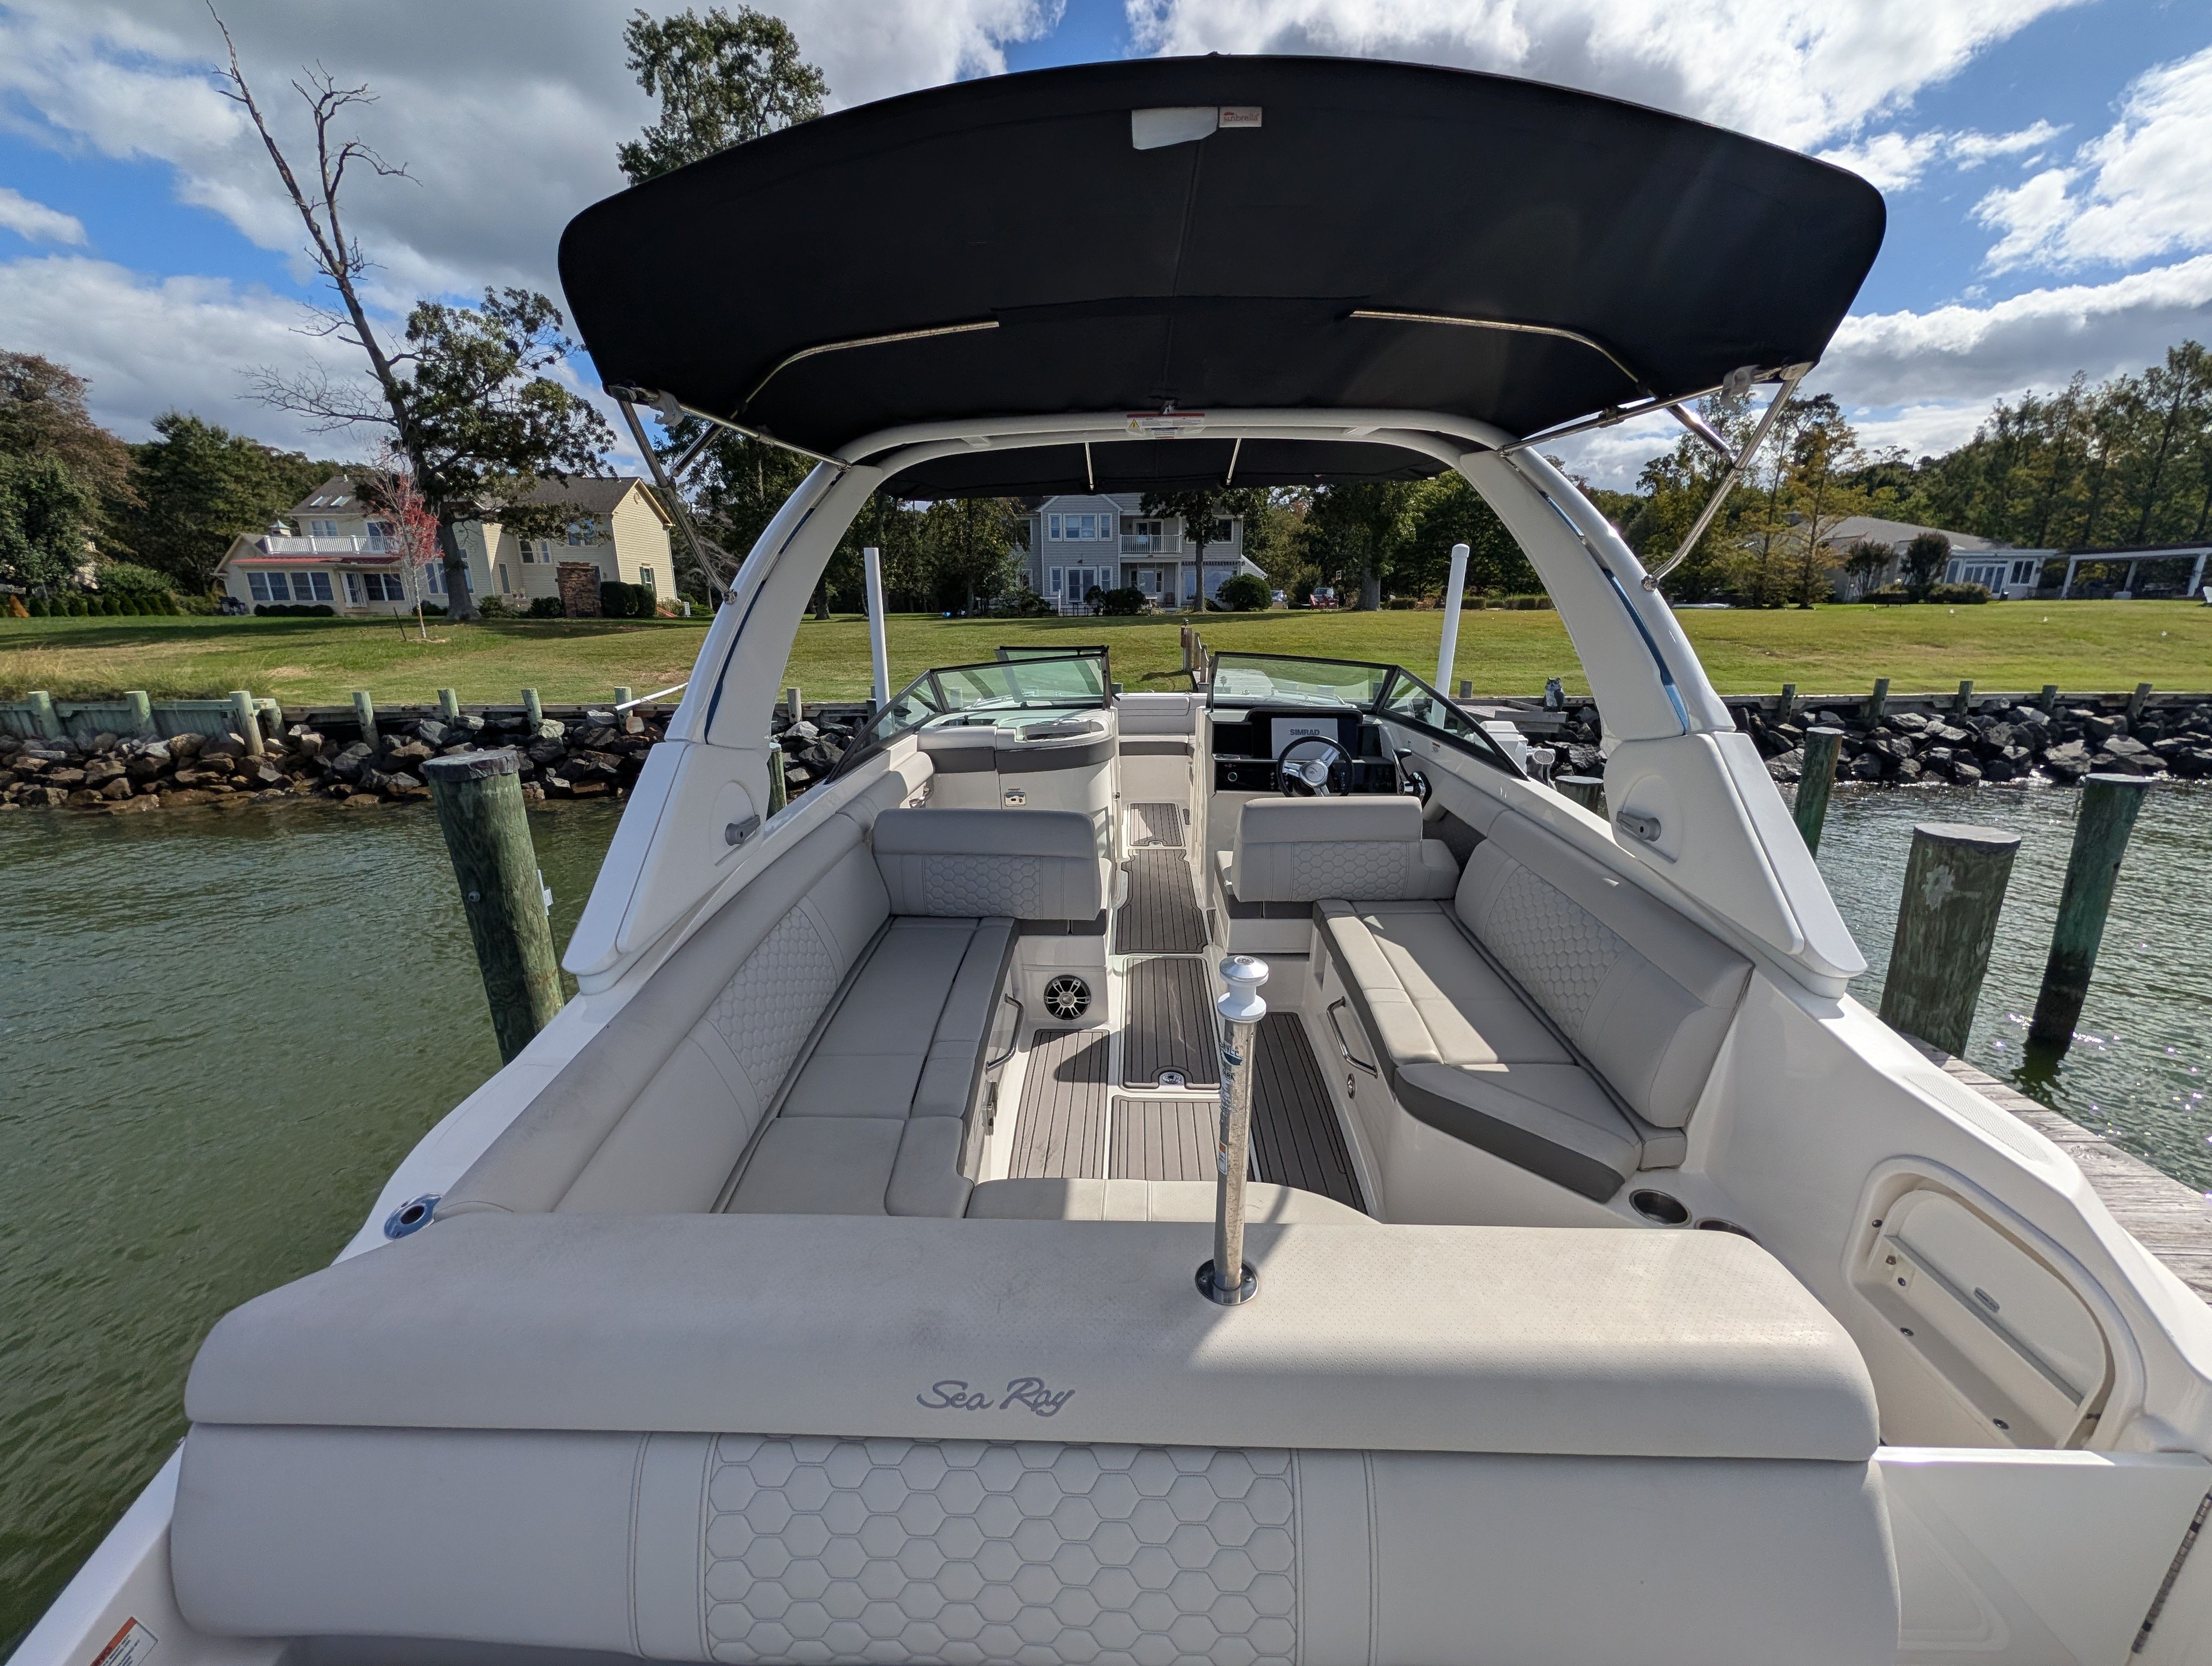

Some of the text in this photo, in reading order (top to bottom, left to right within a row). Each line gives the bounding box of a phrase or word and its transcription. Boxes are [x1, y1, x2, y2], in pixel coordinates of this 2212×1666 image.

[1224, 112, 1258, 122] sunbrella
[917, 1377, 1076, 1417] Sea Ray
